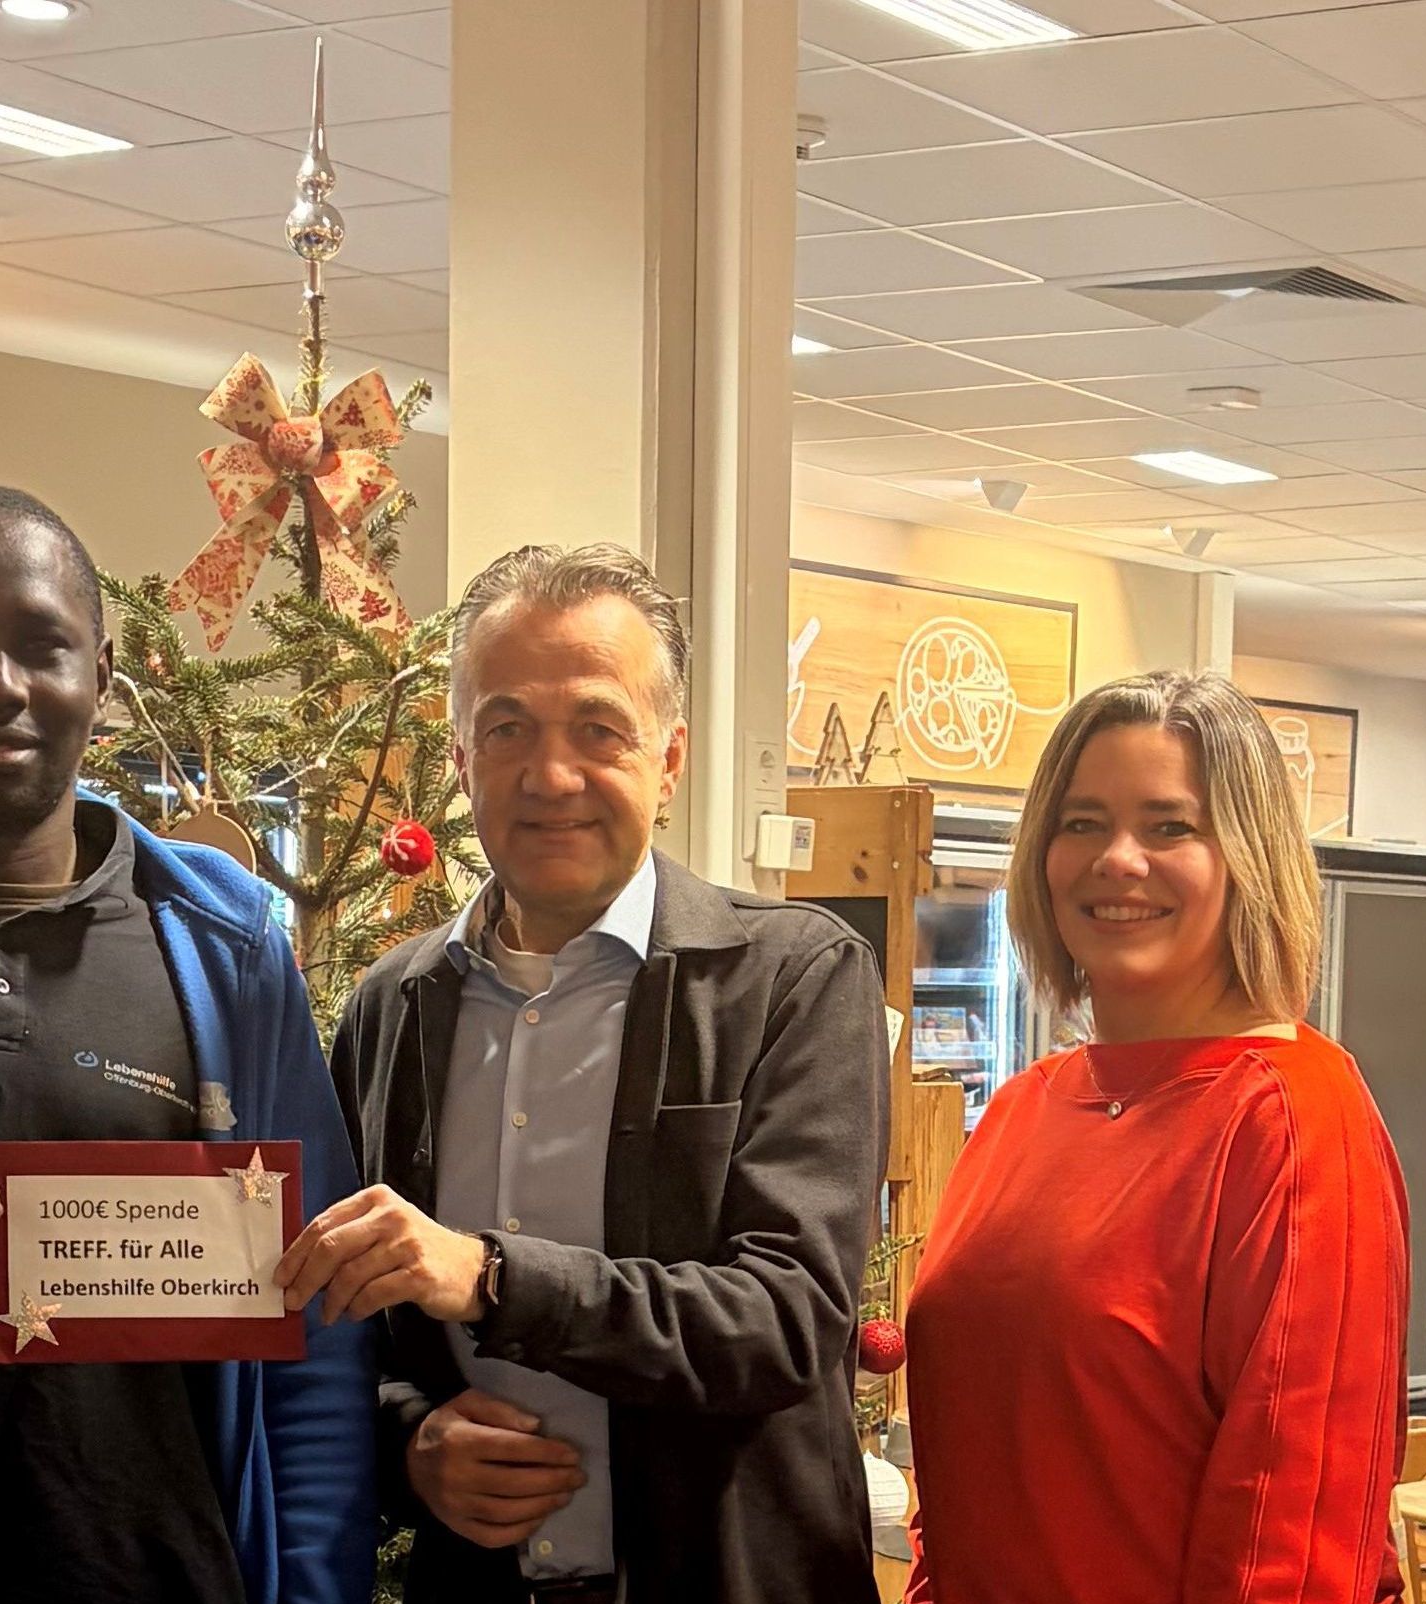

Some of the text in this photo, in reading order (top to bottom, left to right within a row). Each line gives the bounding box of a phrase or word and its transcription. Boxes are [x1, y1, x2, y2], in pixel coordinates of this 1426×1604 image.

[39, 1200, 200, 1223] 1000€ Spende
[39, 1239, 205, 1260] TREFF. für Alle
[40, 1278, 260, 1297] Lebenshilfe Oberkirch
